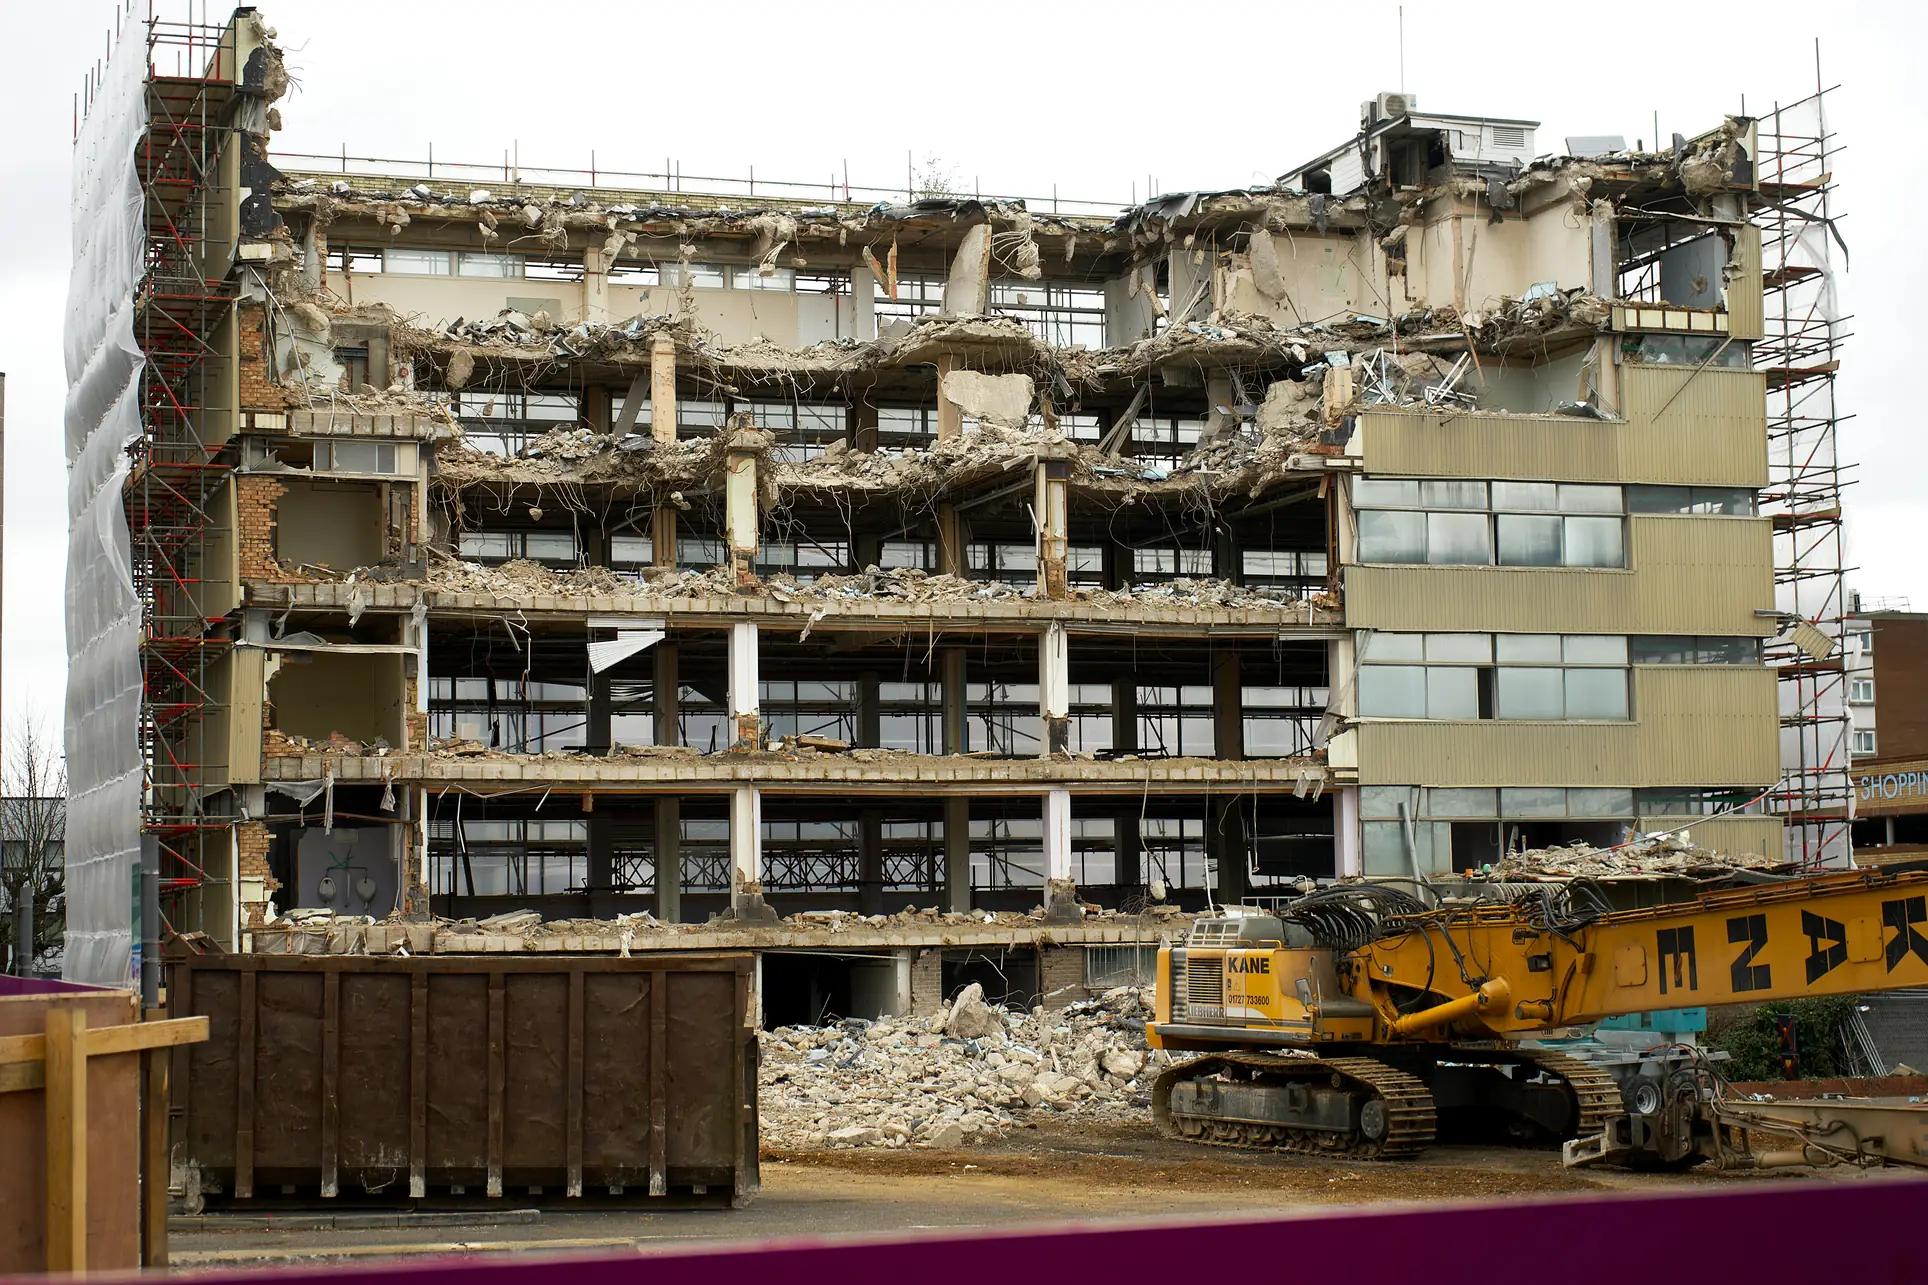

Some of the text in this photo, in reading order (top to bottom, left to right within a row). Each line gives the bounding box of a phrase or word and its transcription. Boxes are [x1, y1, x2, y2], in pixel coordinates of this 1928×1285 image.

[1228, 957, 1270, 974] KANE
[1228, 994, 1269, 1006] 01727 733600
[1188, 1005, 1224, 1018] LIEBHERR
